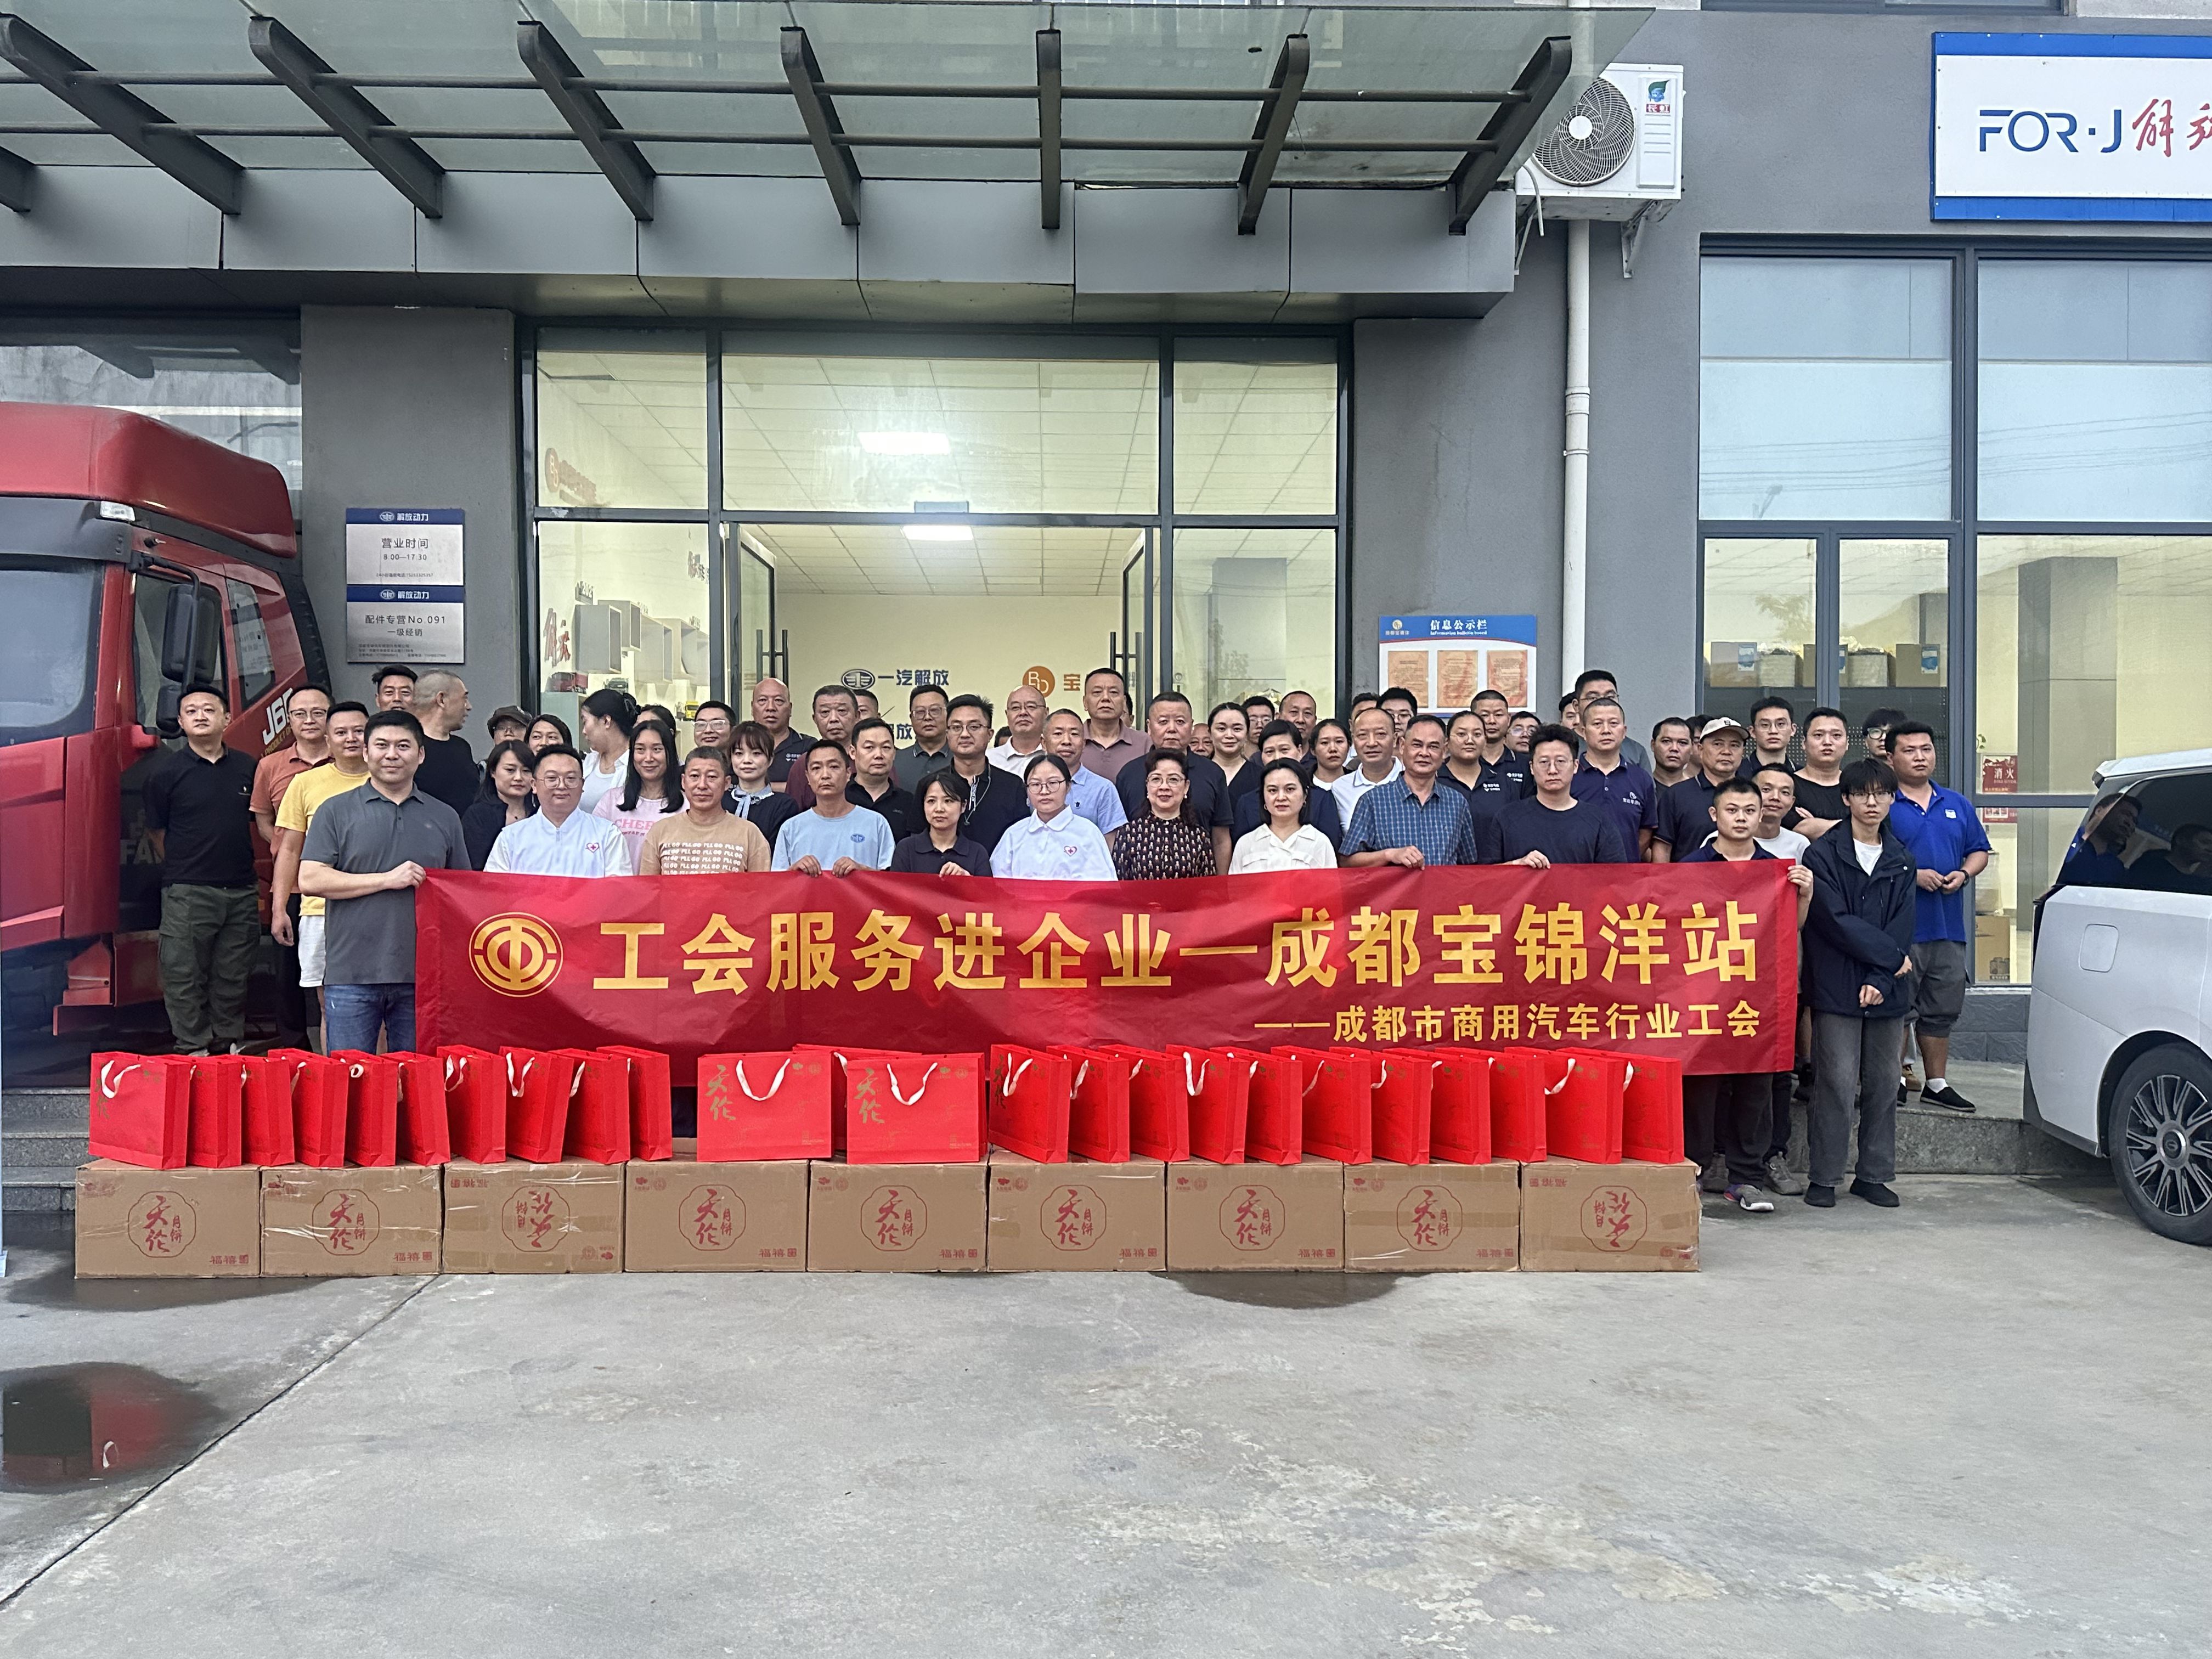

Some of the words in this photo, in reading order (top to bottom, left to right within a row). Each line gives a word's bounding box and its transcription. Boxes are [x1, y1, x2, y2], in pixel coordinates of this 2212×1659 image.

[1647, 104, 1669, 113] 长虹
[397, 512, 429, 521] 解放动力
[381, 538, 428, 549] 营业时间
[397, 591, 430, 599] 解放动力
[1430, 619, 1487, 630] 信息公示栏
[387, 628, 423, 636] 一级经销
[877, 668, 949, 686] 一汽解放
